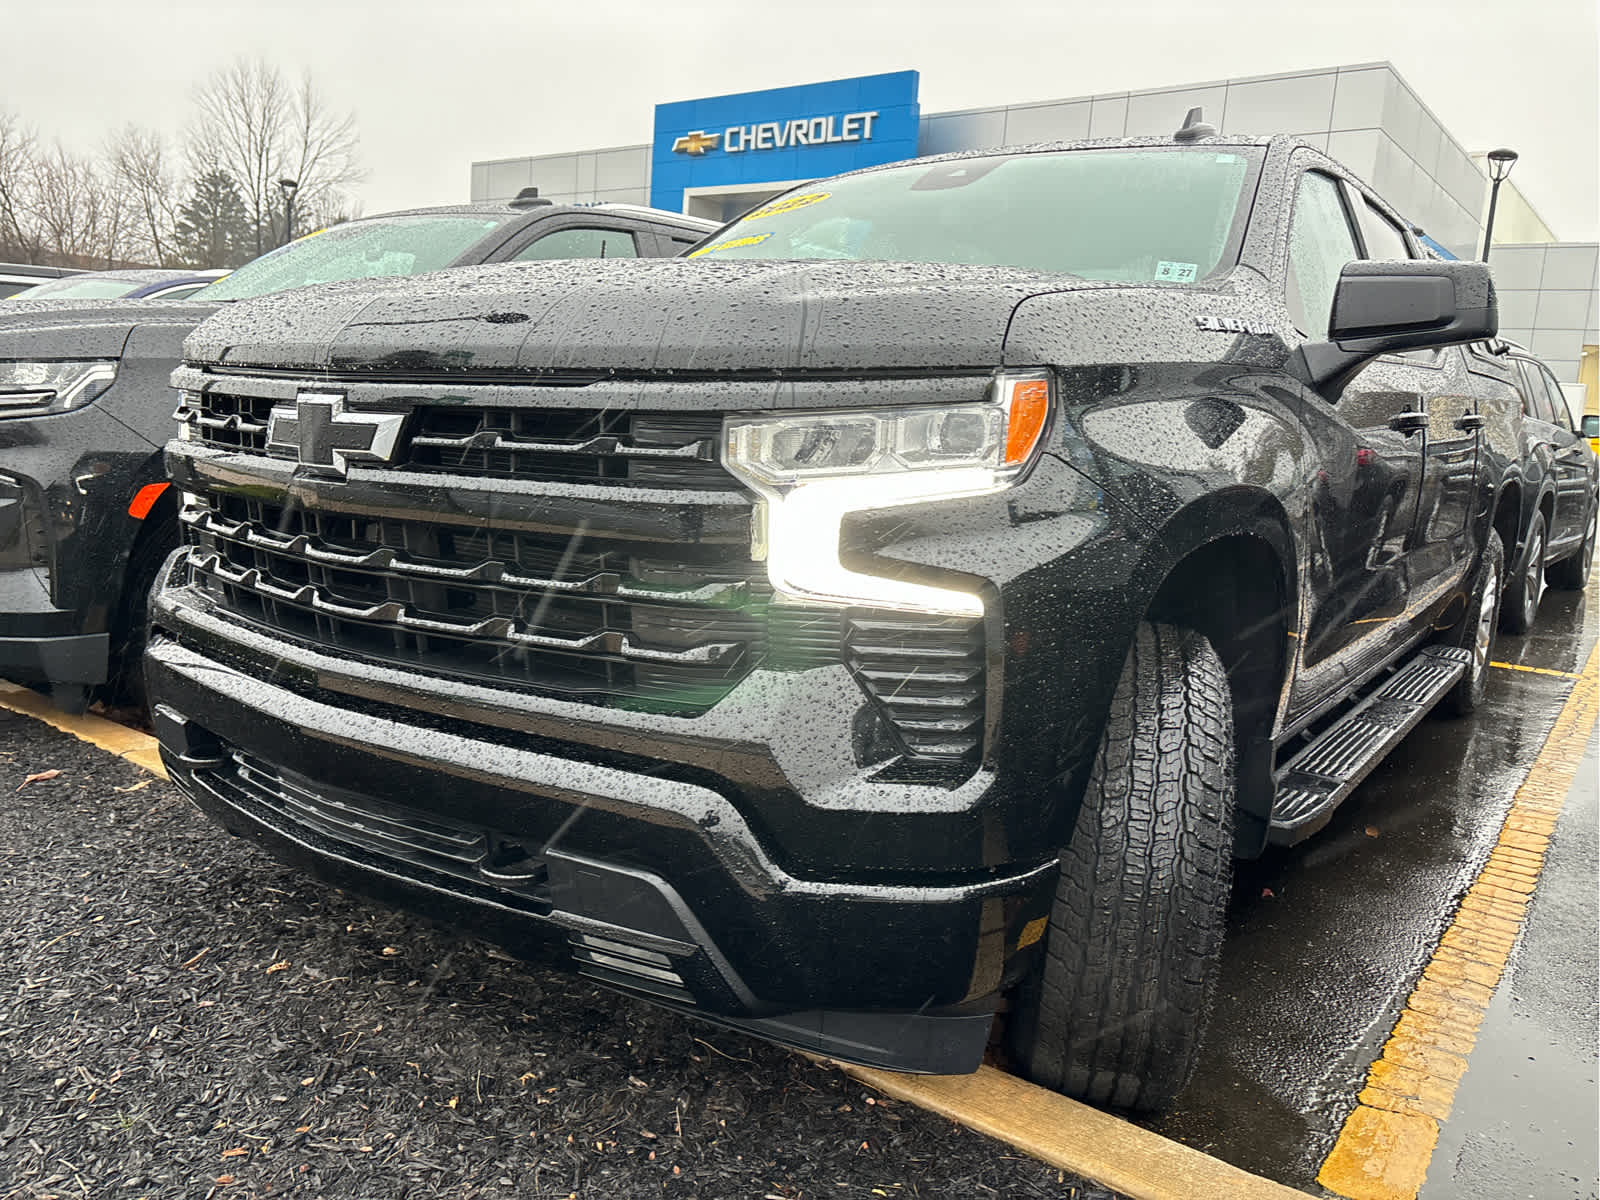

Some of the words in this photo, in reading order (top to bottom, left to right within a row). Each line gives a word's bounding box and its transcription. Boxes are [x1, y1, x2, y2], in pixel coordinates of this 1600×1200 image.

[724, 112, 877, 152] CHEVROLET
[1162, 267, 1170, 276] 8
[1178, 268, 1193, 277] 27
